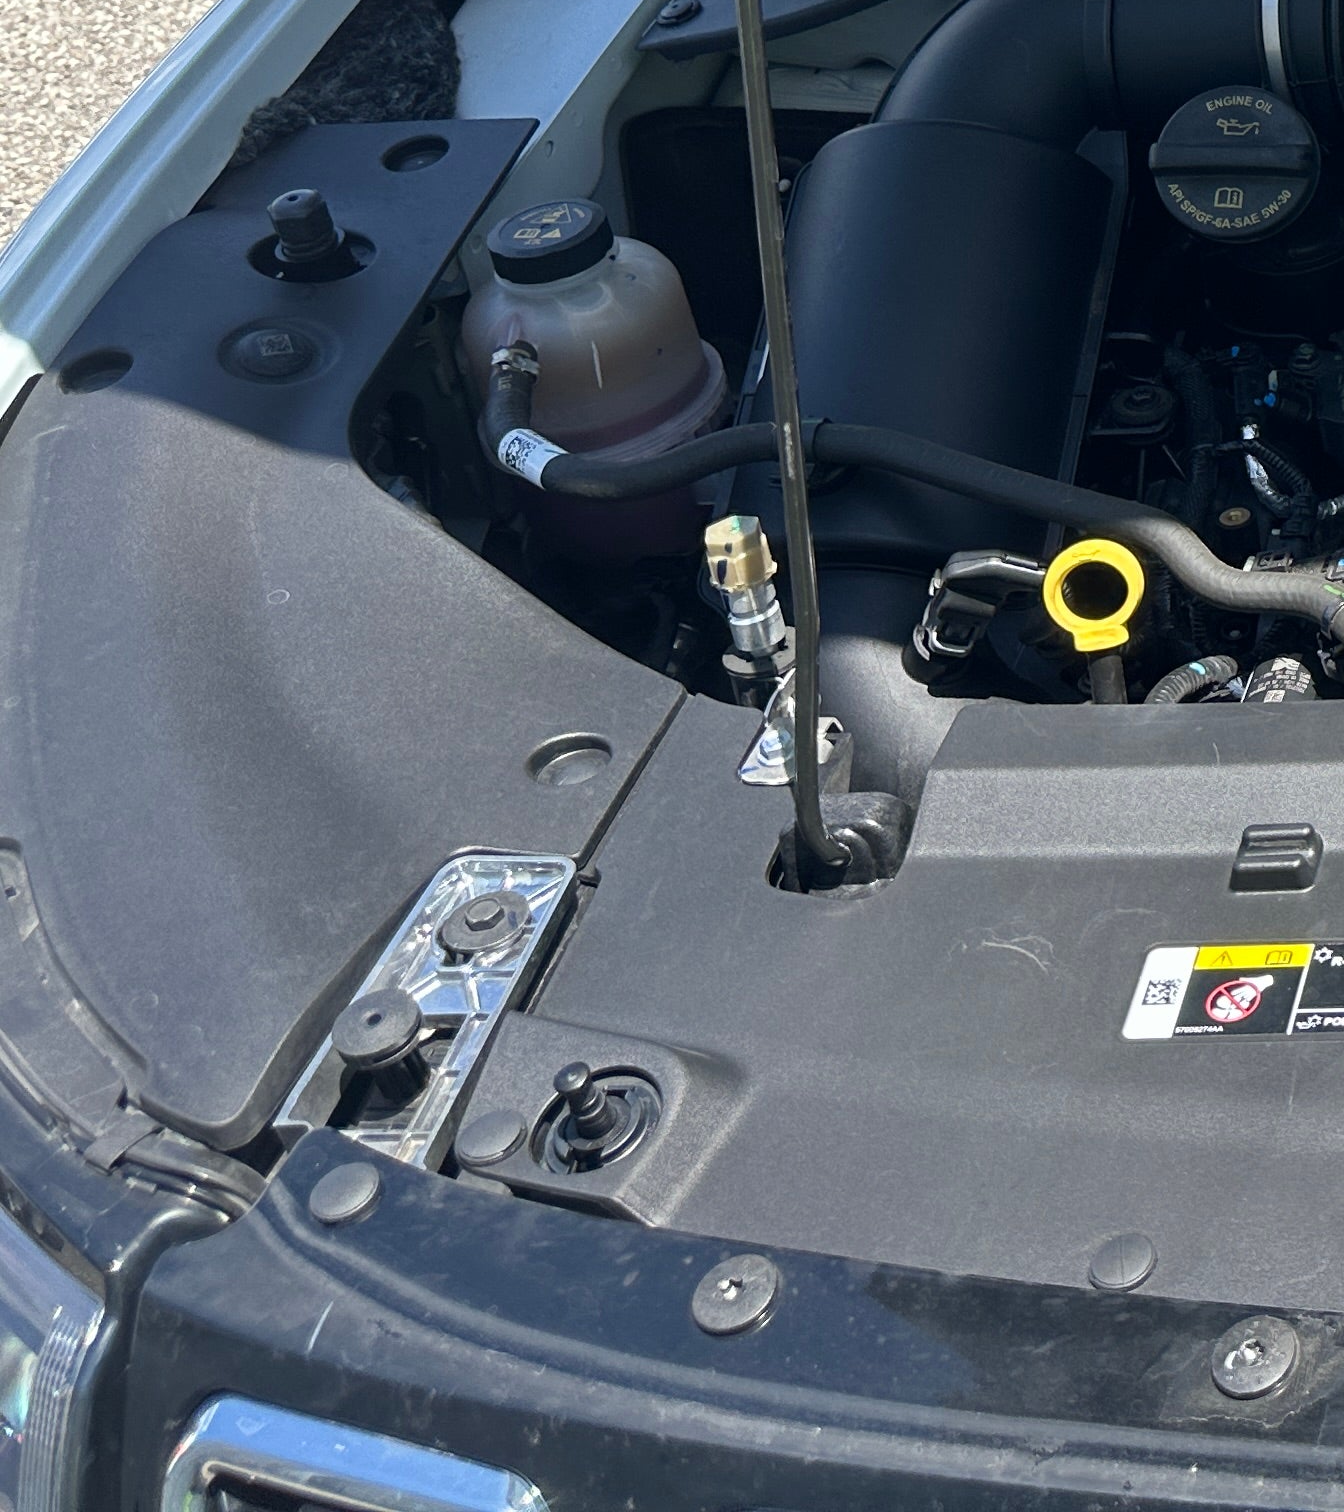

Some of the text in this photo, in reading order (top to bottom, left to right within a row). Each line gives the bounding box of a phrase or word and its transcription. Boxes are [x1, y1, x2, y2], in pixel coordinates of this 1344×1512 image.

[1206, 95, 1274, 115] ENGINE OIL
[1167, 183, 1185, 204] API
[1262, 189, 1292, 219] 5W-30
